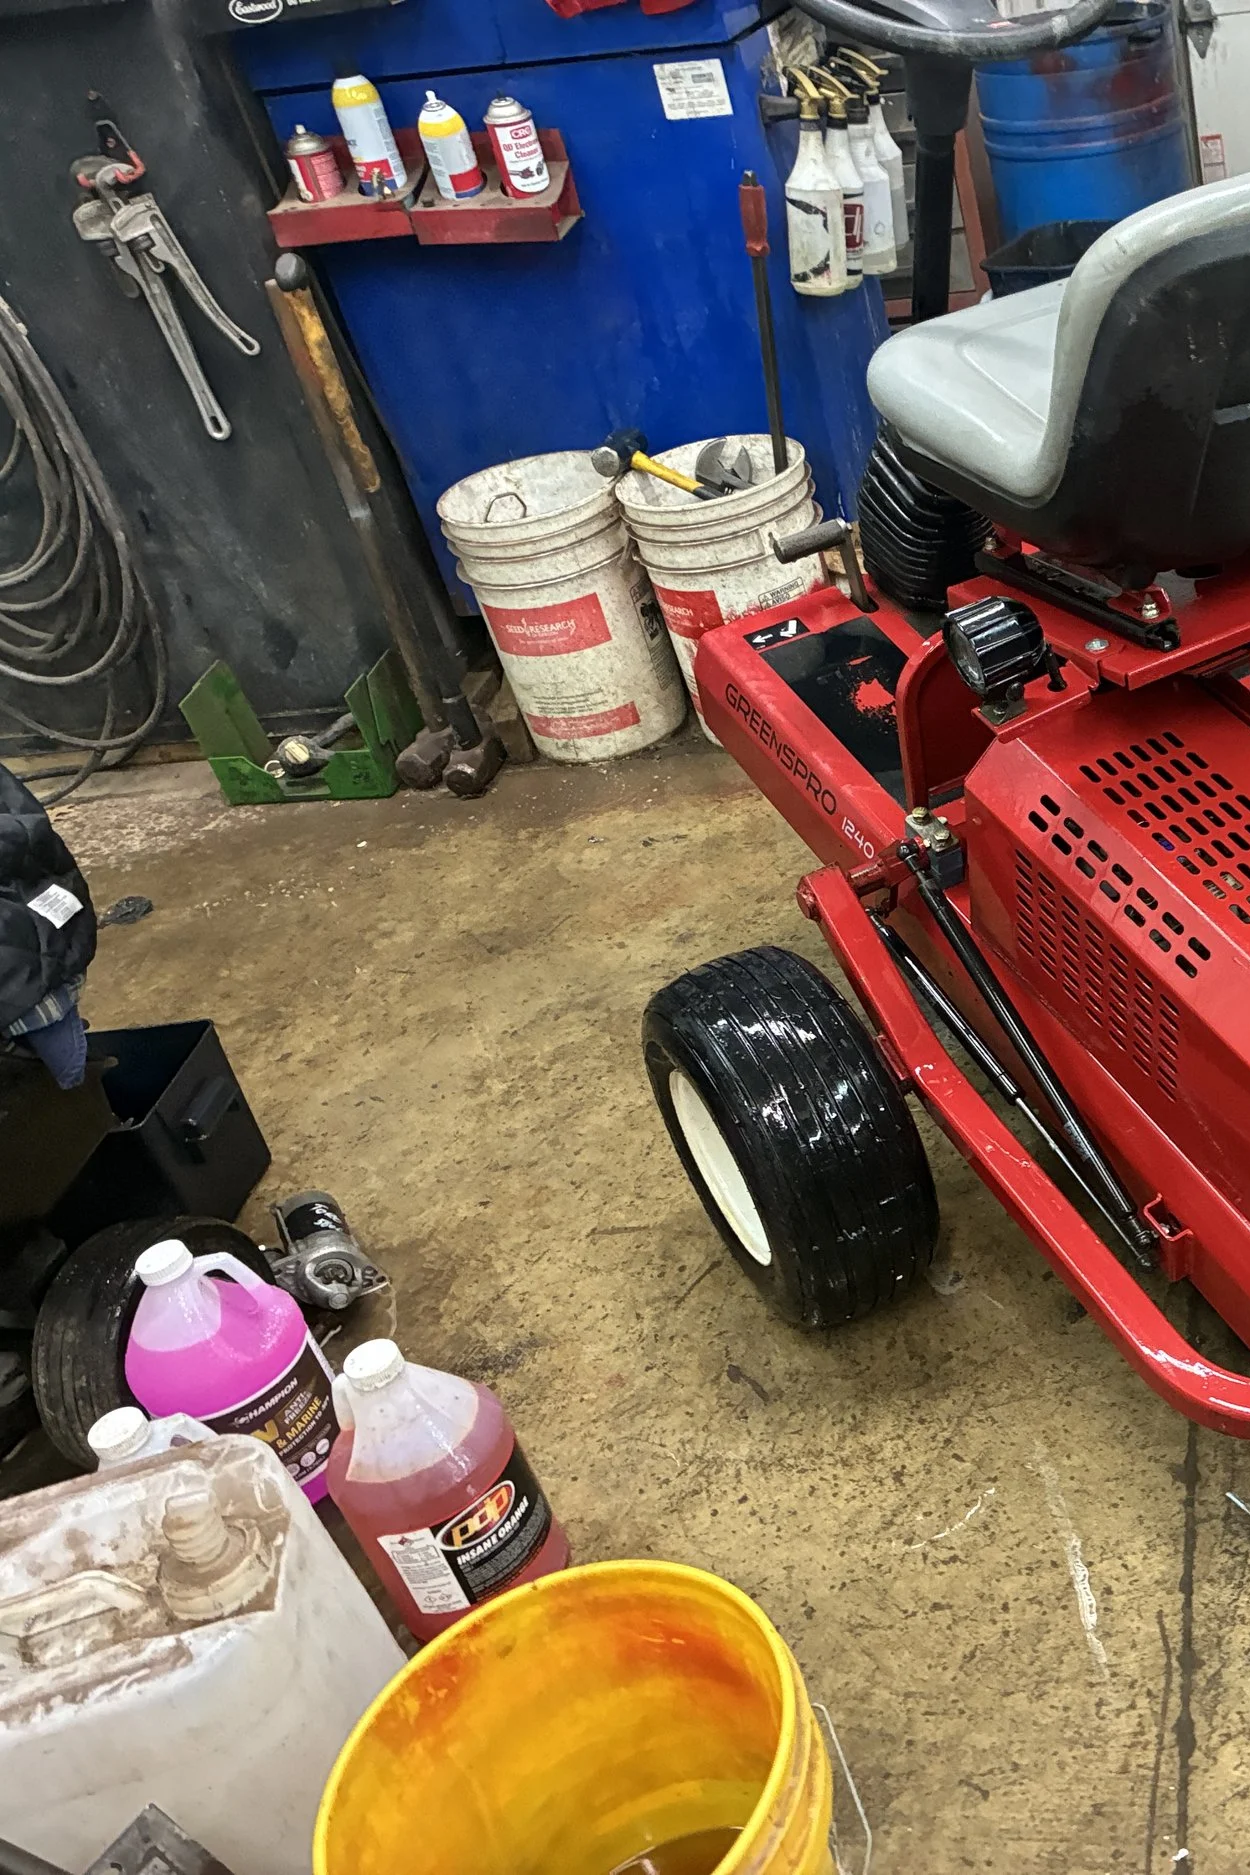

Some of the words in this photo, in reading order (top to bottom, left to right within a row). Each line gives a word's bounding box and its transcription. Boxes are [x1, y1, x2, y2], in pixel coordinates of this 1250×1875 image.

[511, 127, 531, 138] CRC
[529, 619, 576, 636] RESEARCH
[725, 683, 837, 816] GREENSPRO
[841, 816, 875, 860] 1240
[286, 1396, 322, 1440] MARINE
[456, 1528, 498, 1566] INSANE
[497, 1495, 530, 1539] ORANGE
